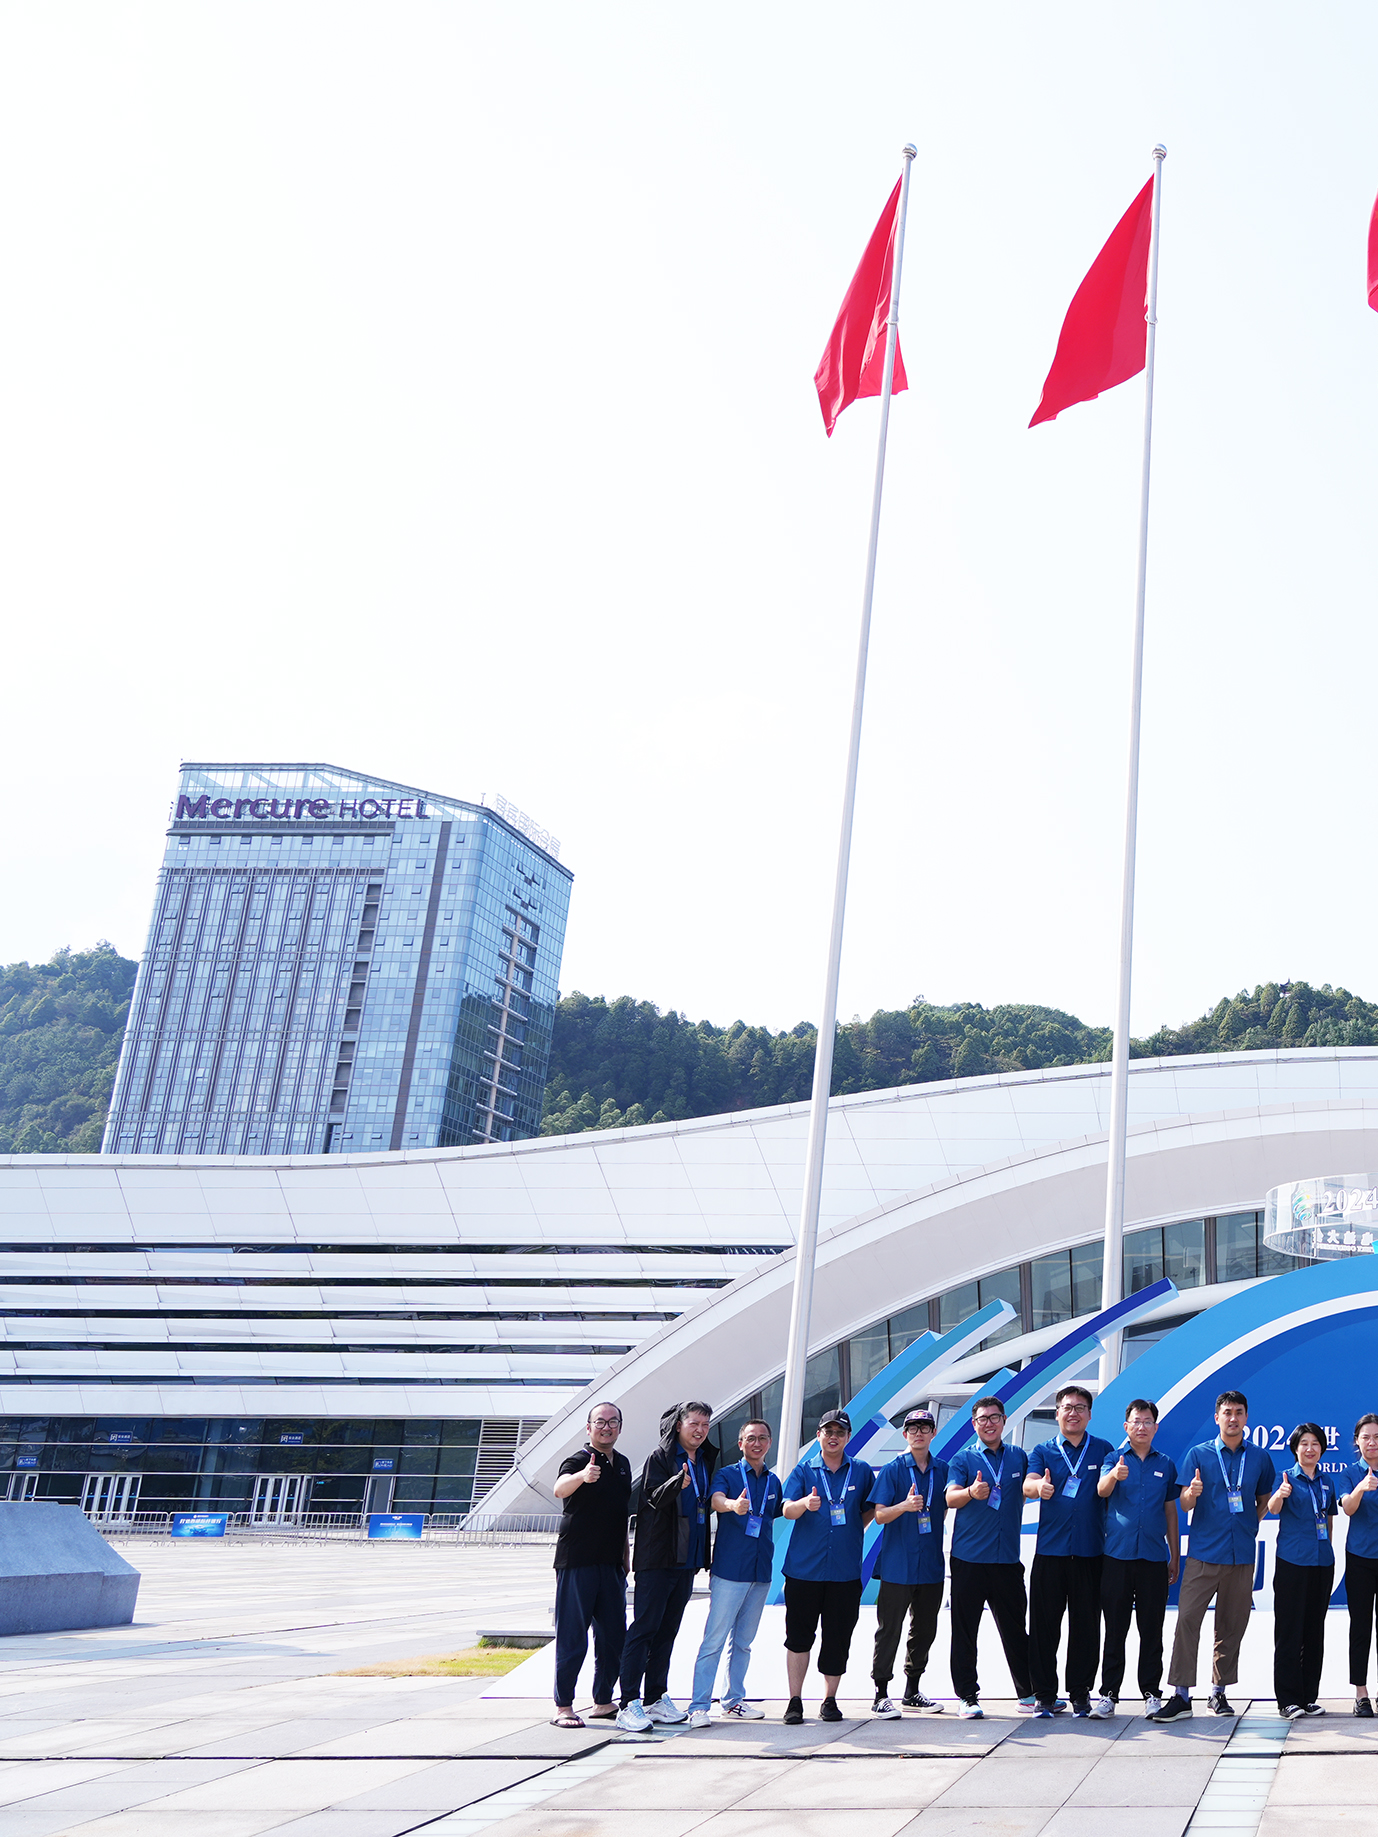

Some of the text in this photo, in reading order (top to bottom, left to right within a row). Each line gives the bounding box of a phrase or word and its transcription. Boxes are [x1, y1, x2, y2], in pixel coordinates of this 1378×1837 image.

[176, 794, 431, 819] Mercure HOTEL
[1322, 1185, 1378, 1213] 2024
